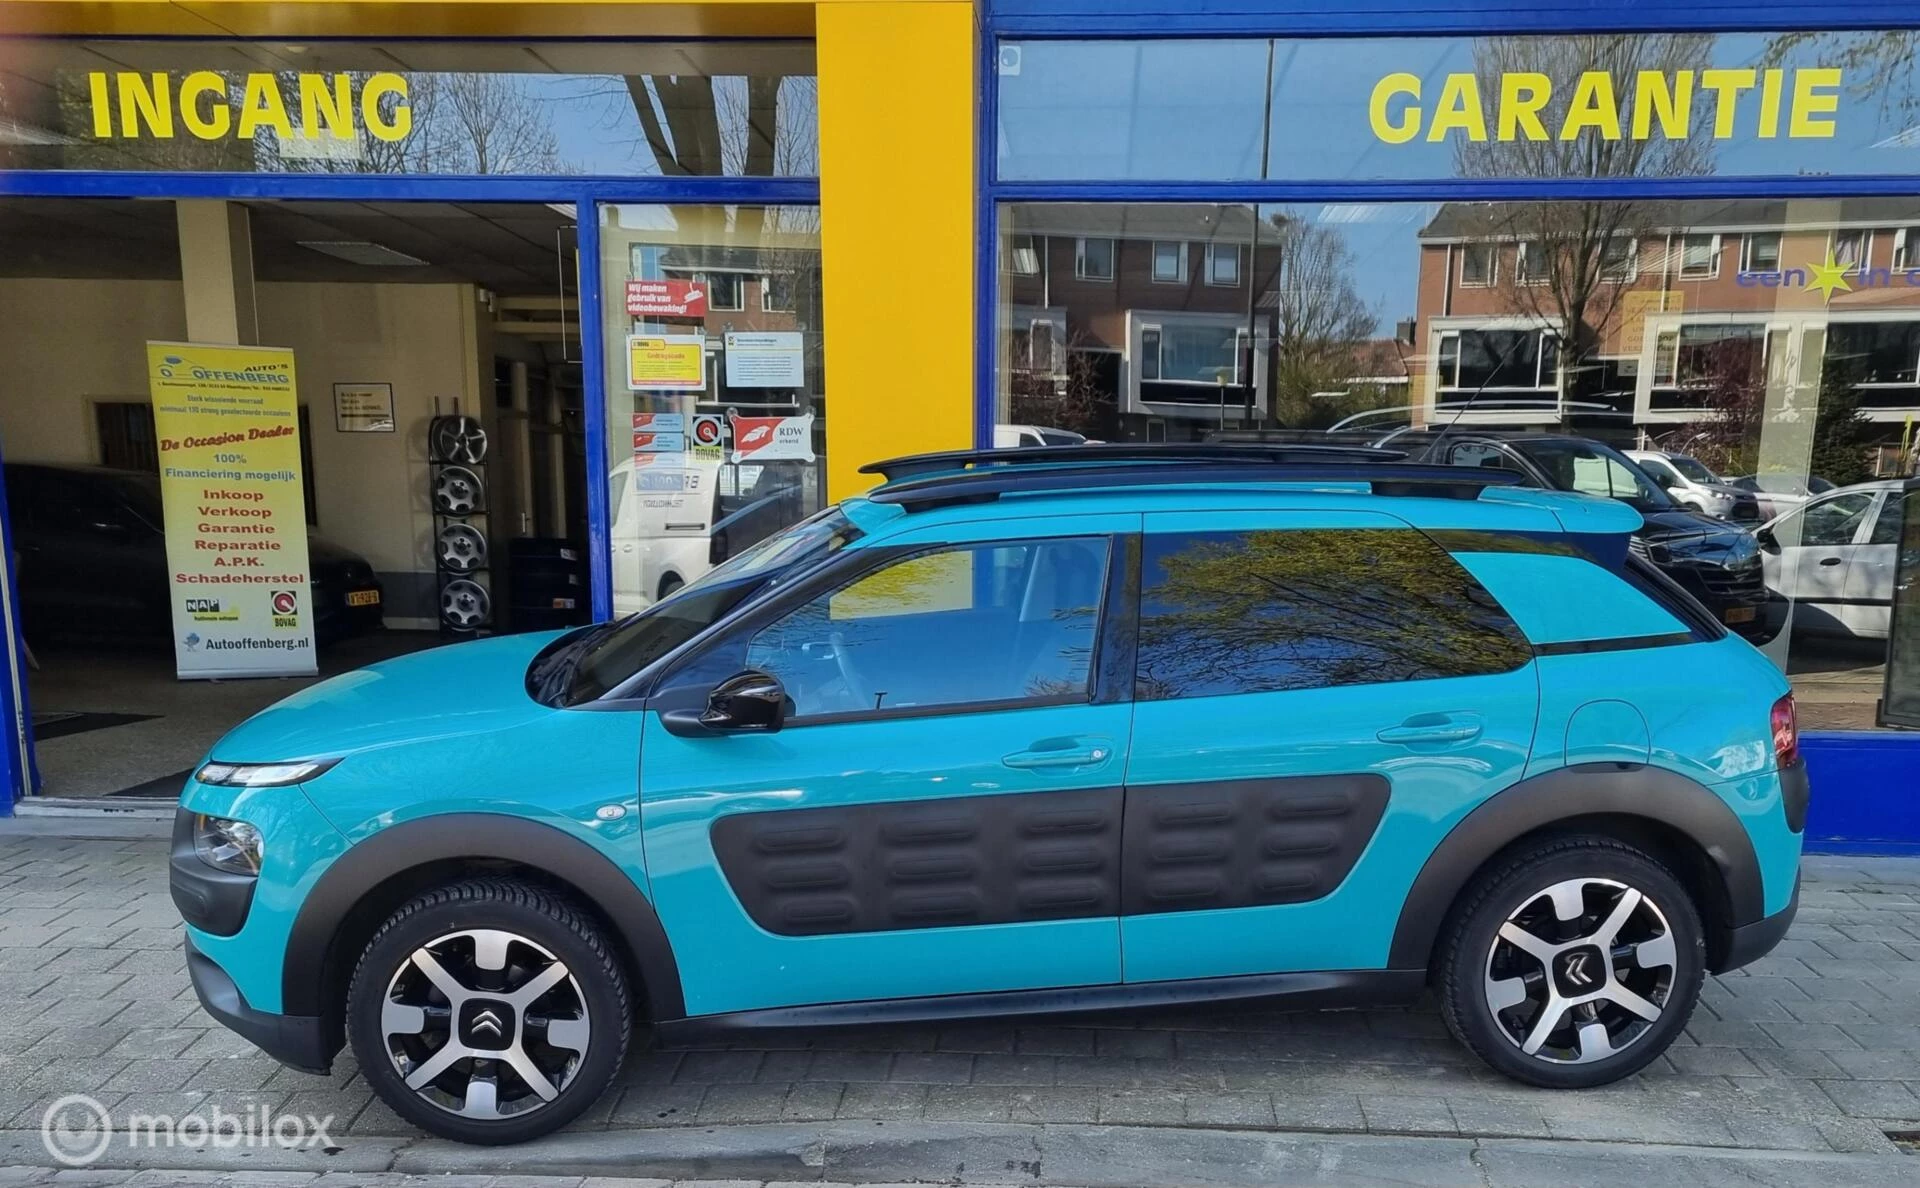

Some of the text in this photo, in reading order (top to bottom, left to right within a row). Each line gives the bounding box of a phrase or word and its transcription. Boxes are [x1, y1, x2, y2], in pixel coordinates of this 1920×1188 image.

[89, 71, 412, 141] INGANG
[1369, 68, 1842, 144] GARANTIE
[1737, 268, 1805, 287] een
[1859, 263, 1890, 287] in
[628, 283, 667, 292] Wij maken
[627, 293, 656, 303] gebruik
[628, 304, 687, 314] videobewaking!
[244, 363, 289, 372] AUTO'S
[193, 370, 289, 383] OFFENBERG
[779, 427, 804, 436] RDW
[160, 425, 295, 451] De Occasion Dealer
[213, 454, 247, 464] 100%
[695, 448, 720, 460] BOVAG
[165, 468, 296, 481] Financiering mogelijk
[203, 490, 264, 502] Inkoop
[198, 507, 272, 519] Verkoop
[198, 523, 276, 534] Garantie
[195, 540, 281, 552] Reparatie
[214, 557, 265, 567] A.P.K.
[176, 574, 304, 584] Schadeherstel
[186, 600, 220, 612] NAP
[275, 618, 297, 627] BOVAG
[205, 637, 309, 650] Autooffenberg.nl
